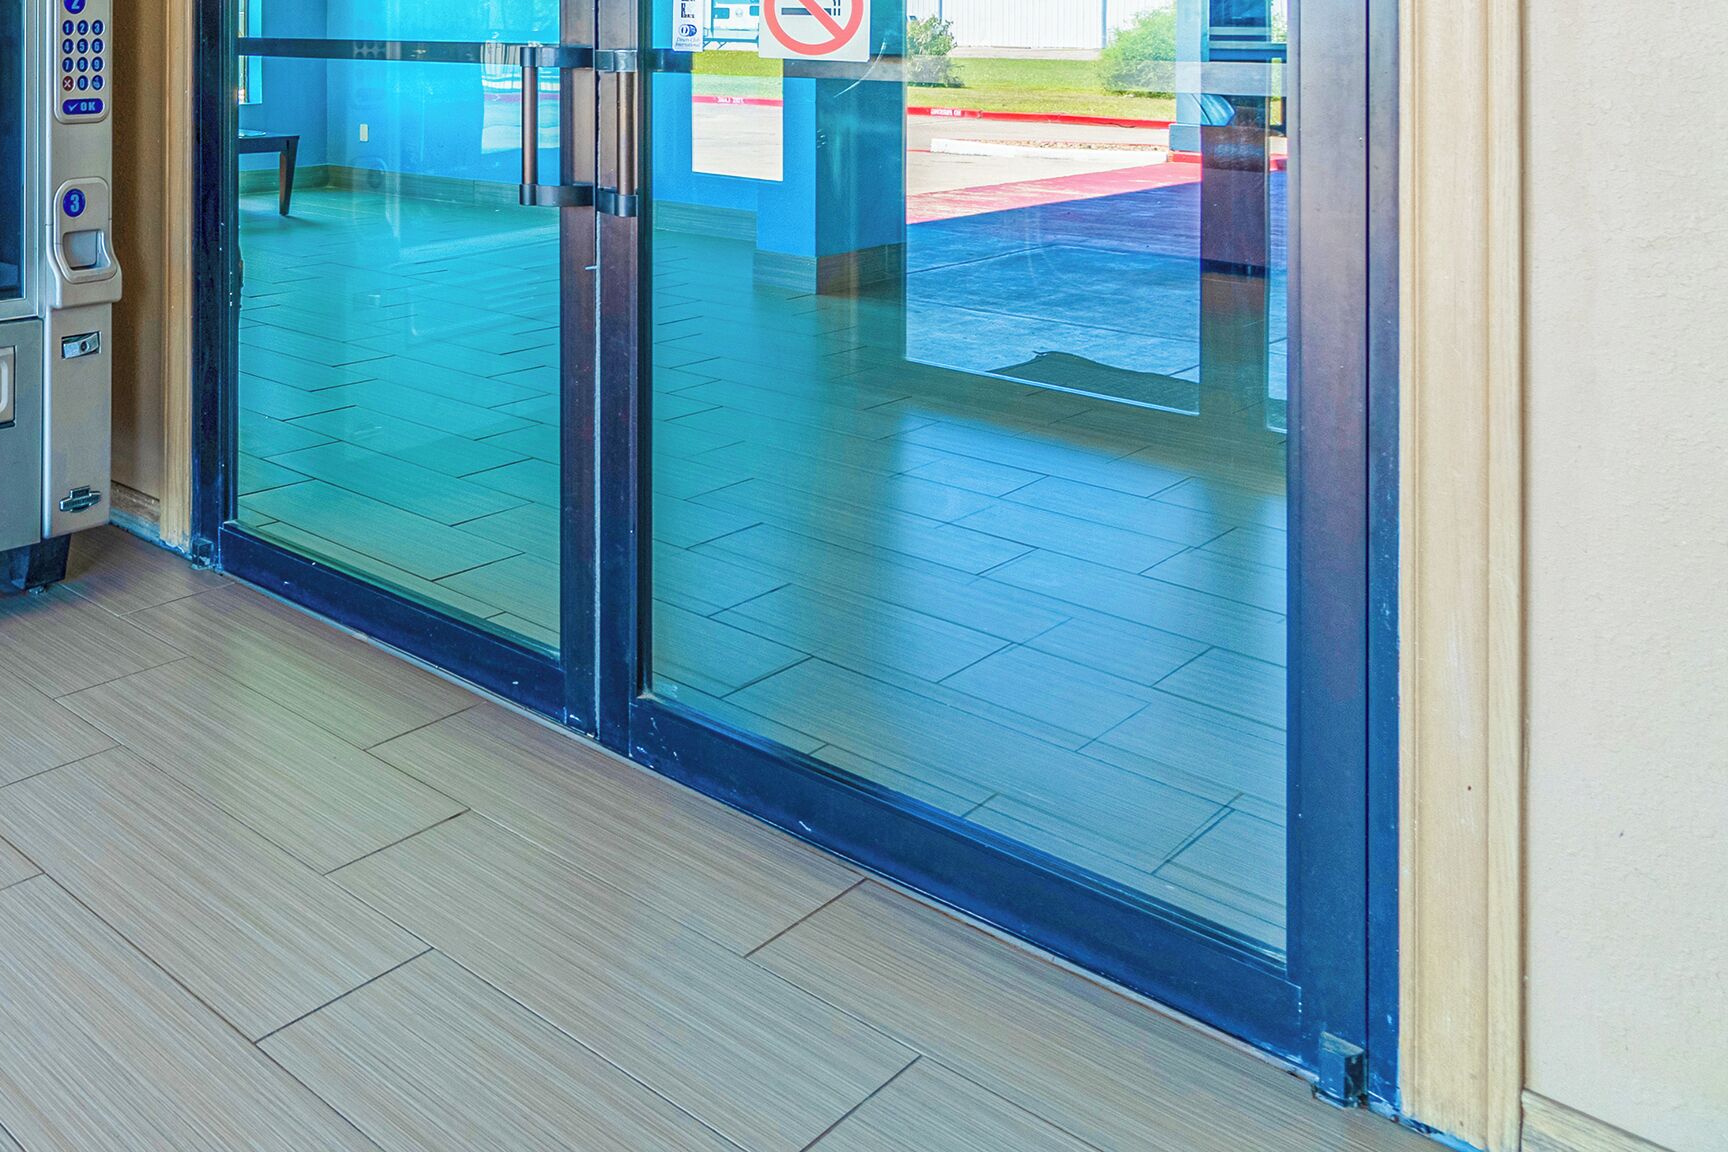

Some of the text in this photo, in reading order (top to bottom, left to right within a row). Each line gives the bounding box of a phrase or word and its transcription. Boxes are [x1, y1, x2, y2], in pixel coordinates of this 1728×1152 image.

[65, 23, 100, 32] 1 2 3
[64, 42, 100, 51] 4 5 6
[65, 60, 100, 70] 7 8 9
[80, 79, 85, 88] 0
[80, 101, 96, 111] OK
[70, 194, 79, 213] 3
